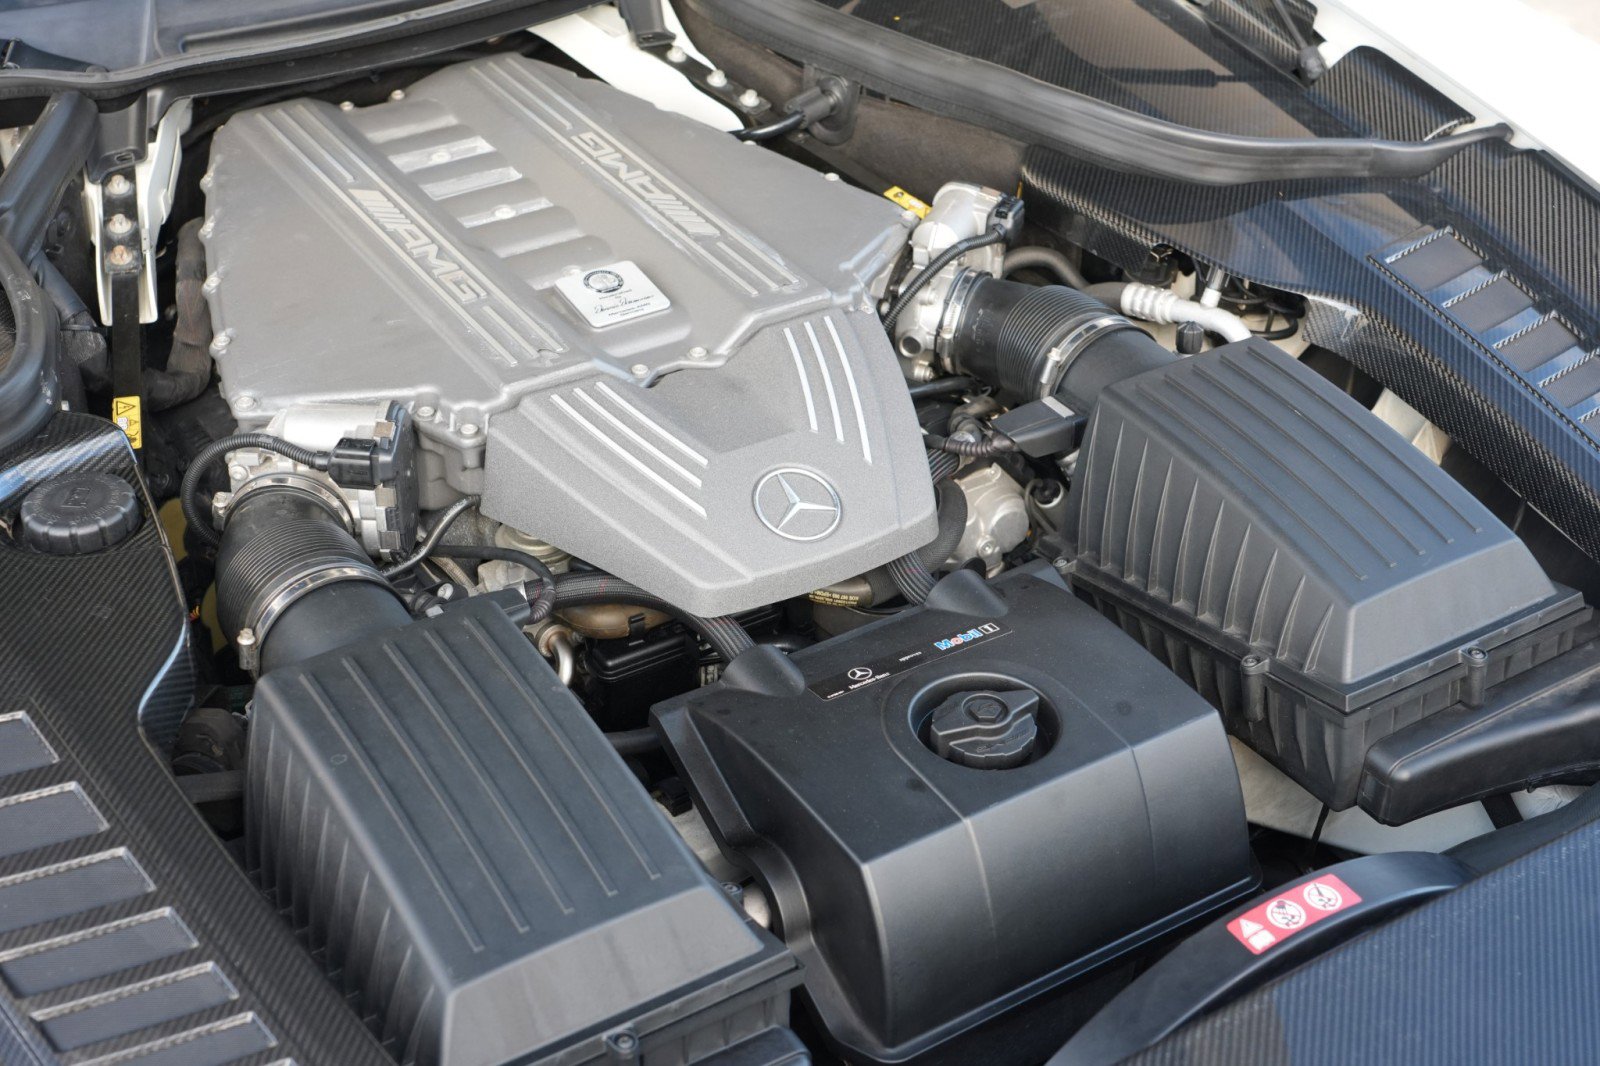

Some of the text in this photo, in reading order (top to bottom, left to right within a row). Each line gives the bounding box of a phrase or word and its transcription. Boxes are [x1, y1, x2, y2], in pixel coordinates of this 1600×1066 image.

[570, 131, 677, 201] AMG
[379, 222, 488, 304] AMG
[934, 628, 984, 651] Mobil
